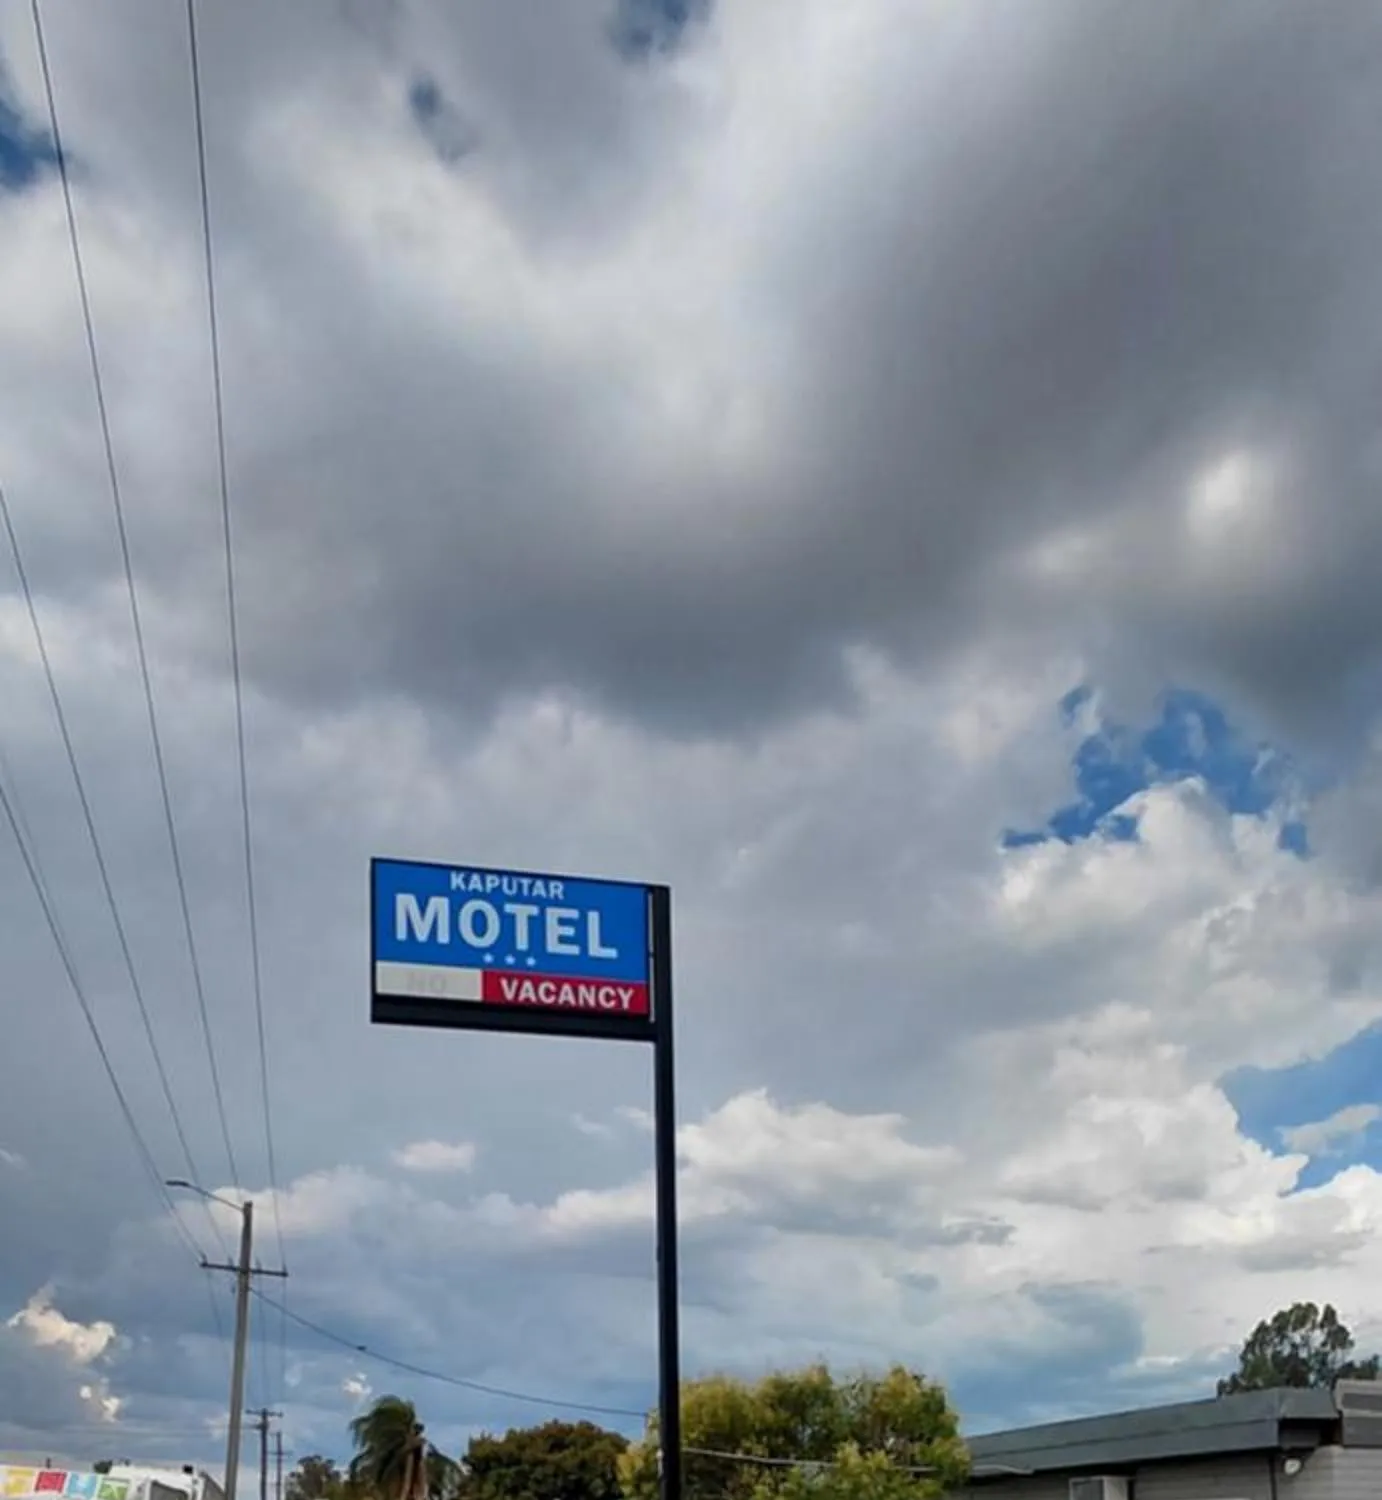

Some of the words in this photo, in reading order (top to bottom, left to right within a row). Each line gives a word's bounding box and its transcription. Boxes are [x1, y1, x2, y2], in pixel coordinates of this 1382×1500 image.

[450, 872, 565, 899] KAPUTAR
[396, 894, 618, 959] MOTEL
[500, 978, 634, 1009] VACANCY
